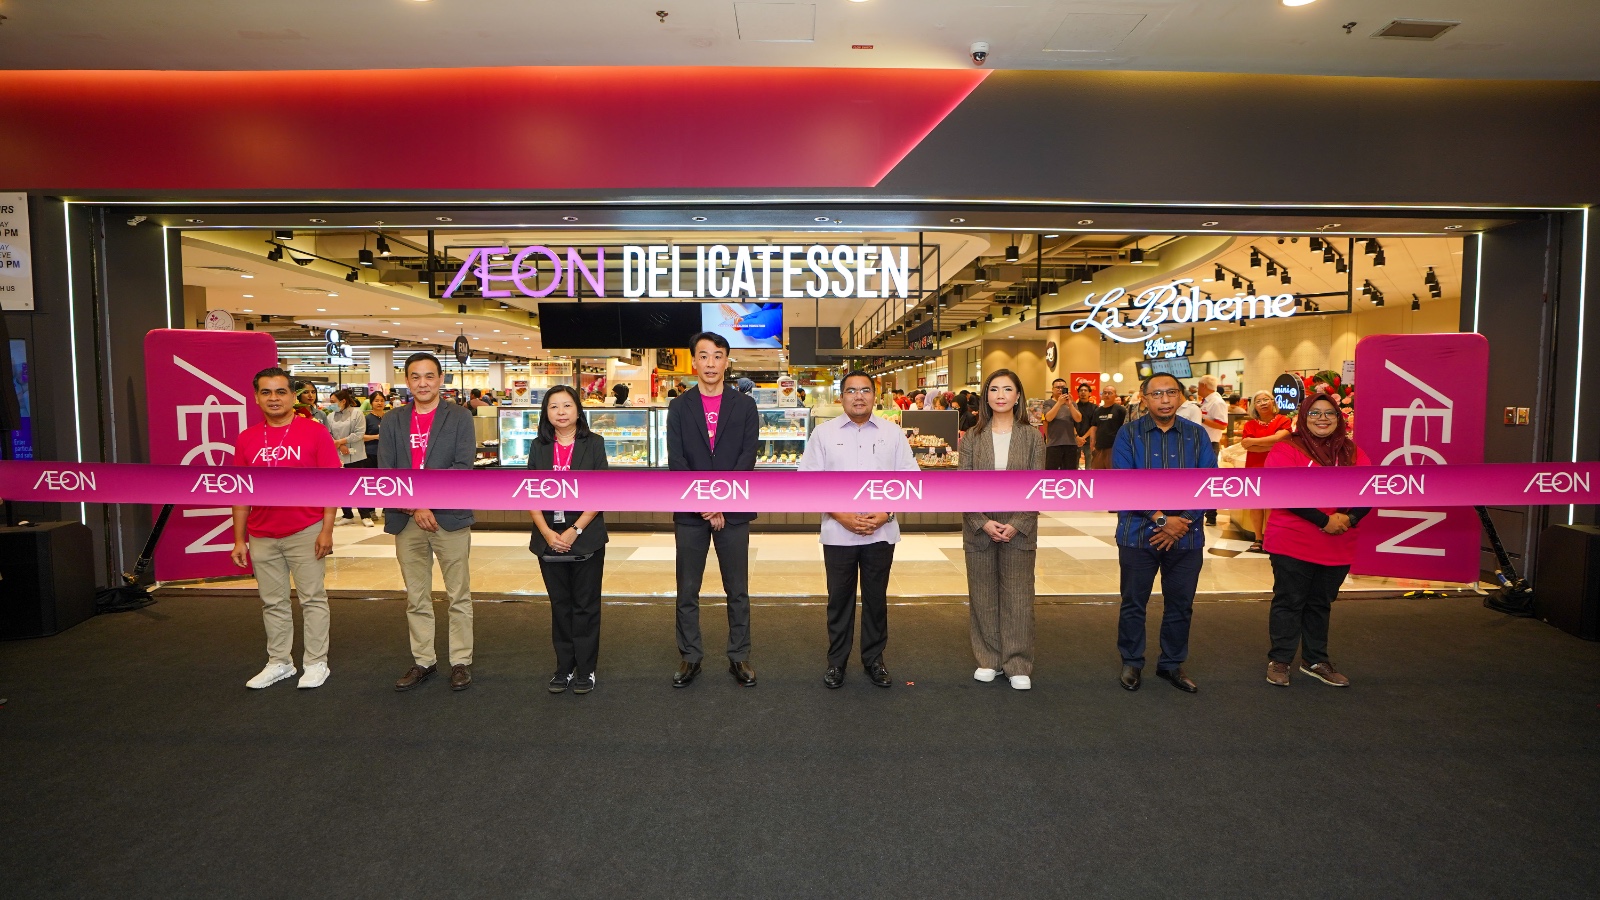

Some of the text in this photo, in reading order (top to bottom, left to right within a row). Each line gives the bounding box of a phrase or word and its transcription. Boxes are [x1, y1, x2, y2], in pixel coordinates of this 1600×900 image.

[5, 229, 18, 237] PM
[623, 245, 909, 298] DELICATESSEN
[1070, 278, 1297, 341] La Boheme
[1274, 385, 1290, 394] mini
